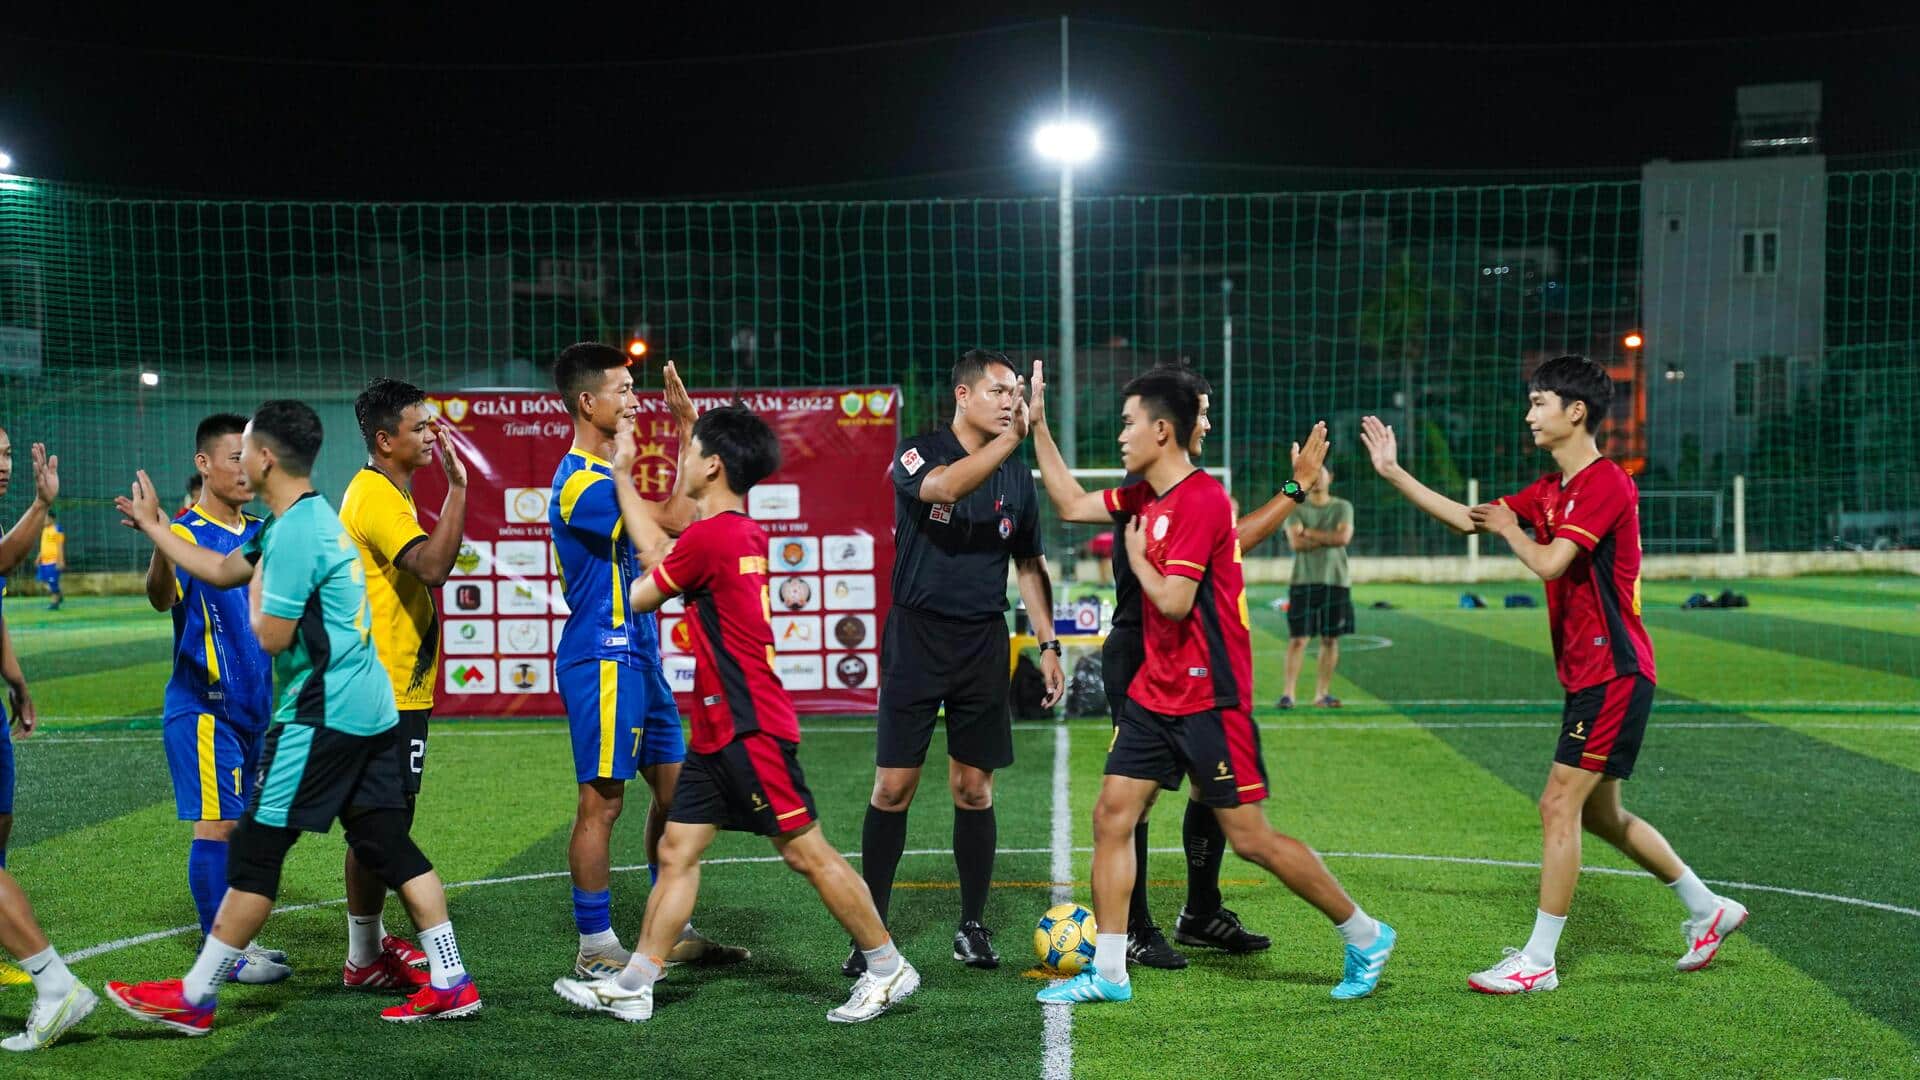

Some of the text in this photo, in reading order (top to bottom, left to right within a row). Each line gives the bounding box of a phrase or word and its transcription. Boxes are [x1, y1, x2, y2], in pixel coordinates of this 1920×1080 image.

[473, 397, 515, 415] GIẢI
[521, 396, 570, 415] BÓN
[787, 397, 834, 411] 2022
[503, 421, 540, 437] Tranh
